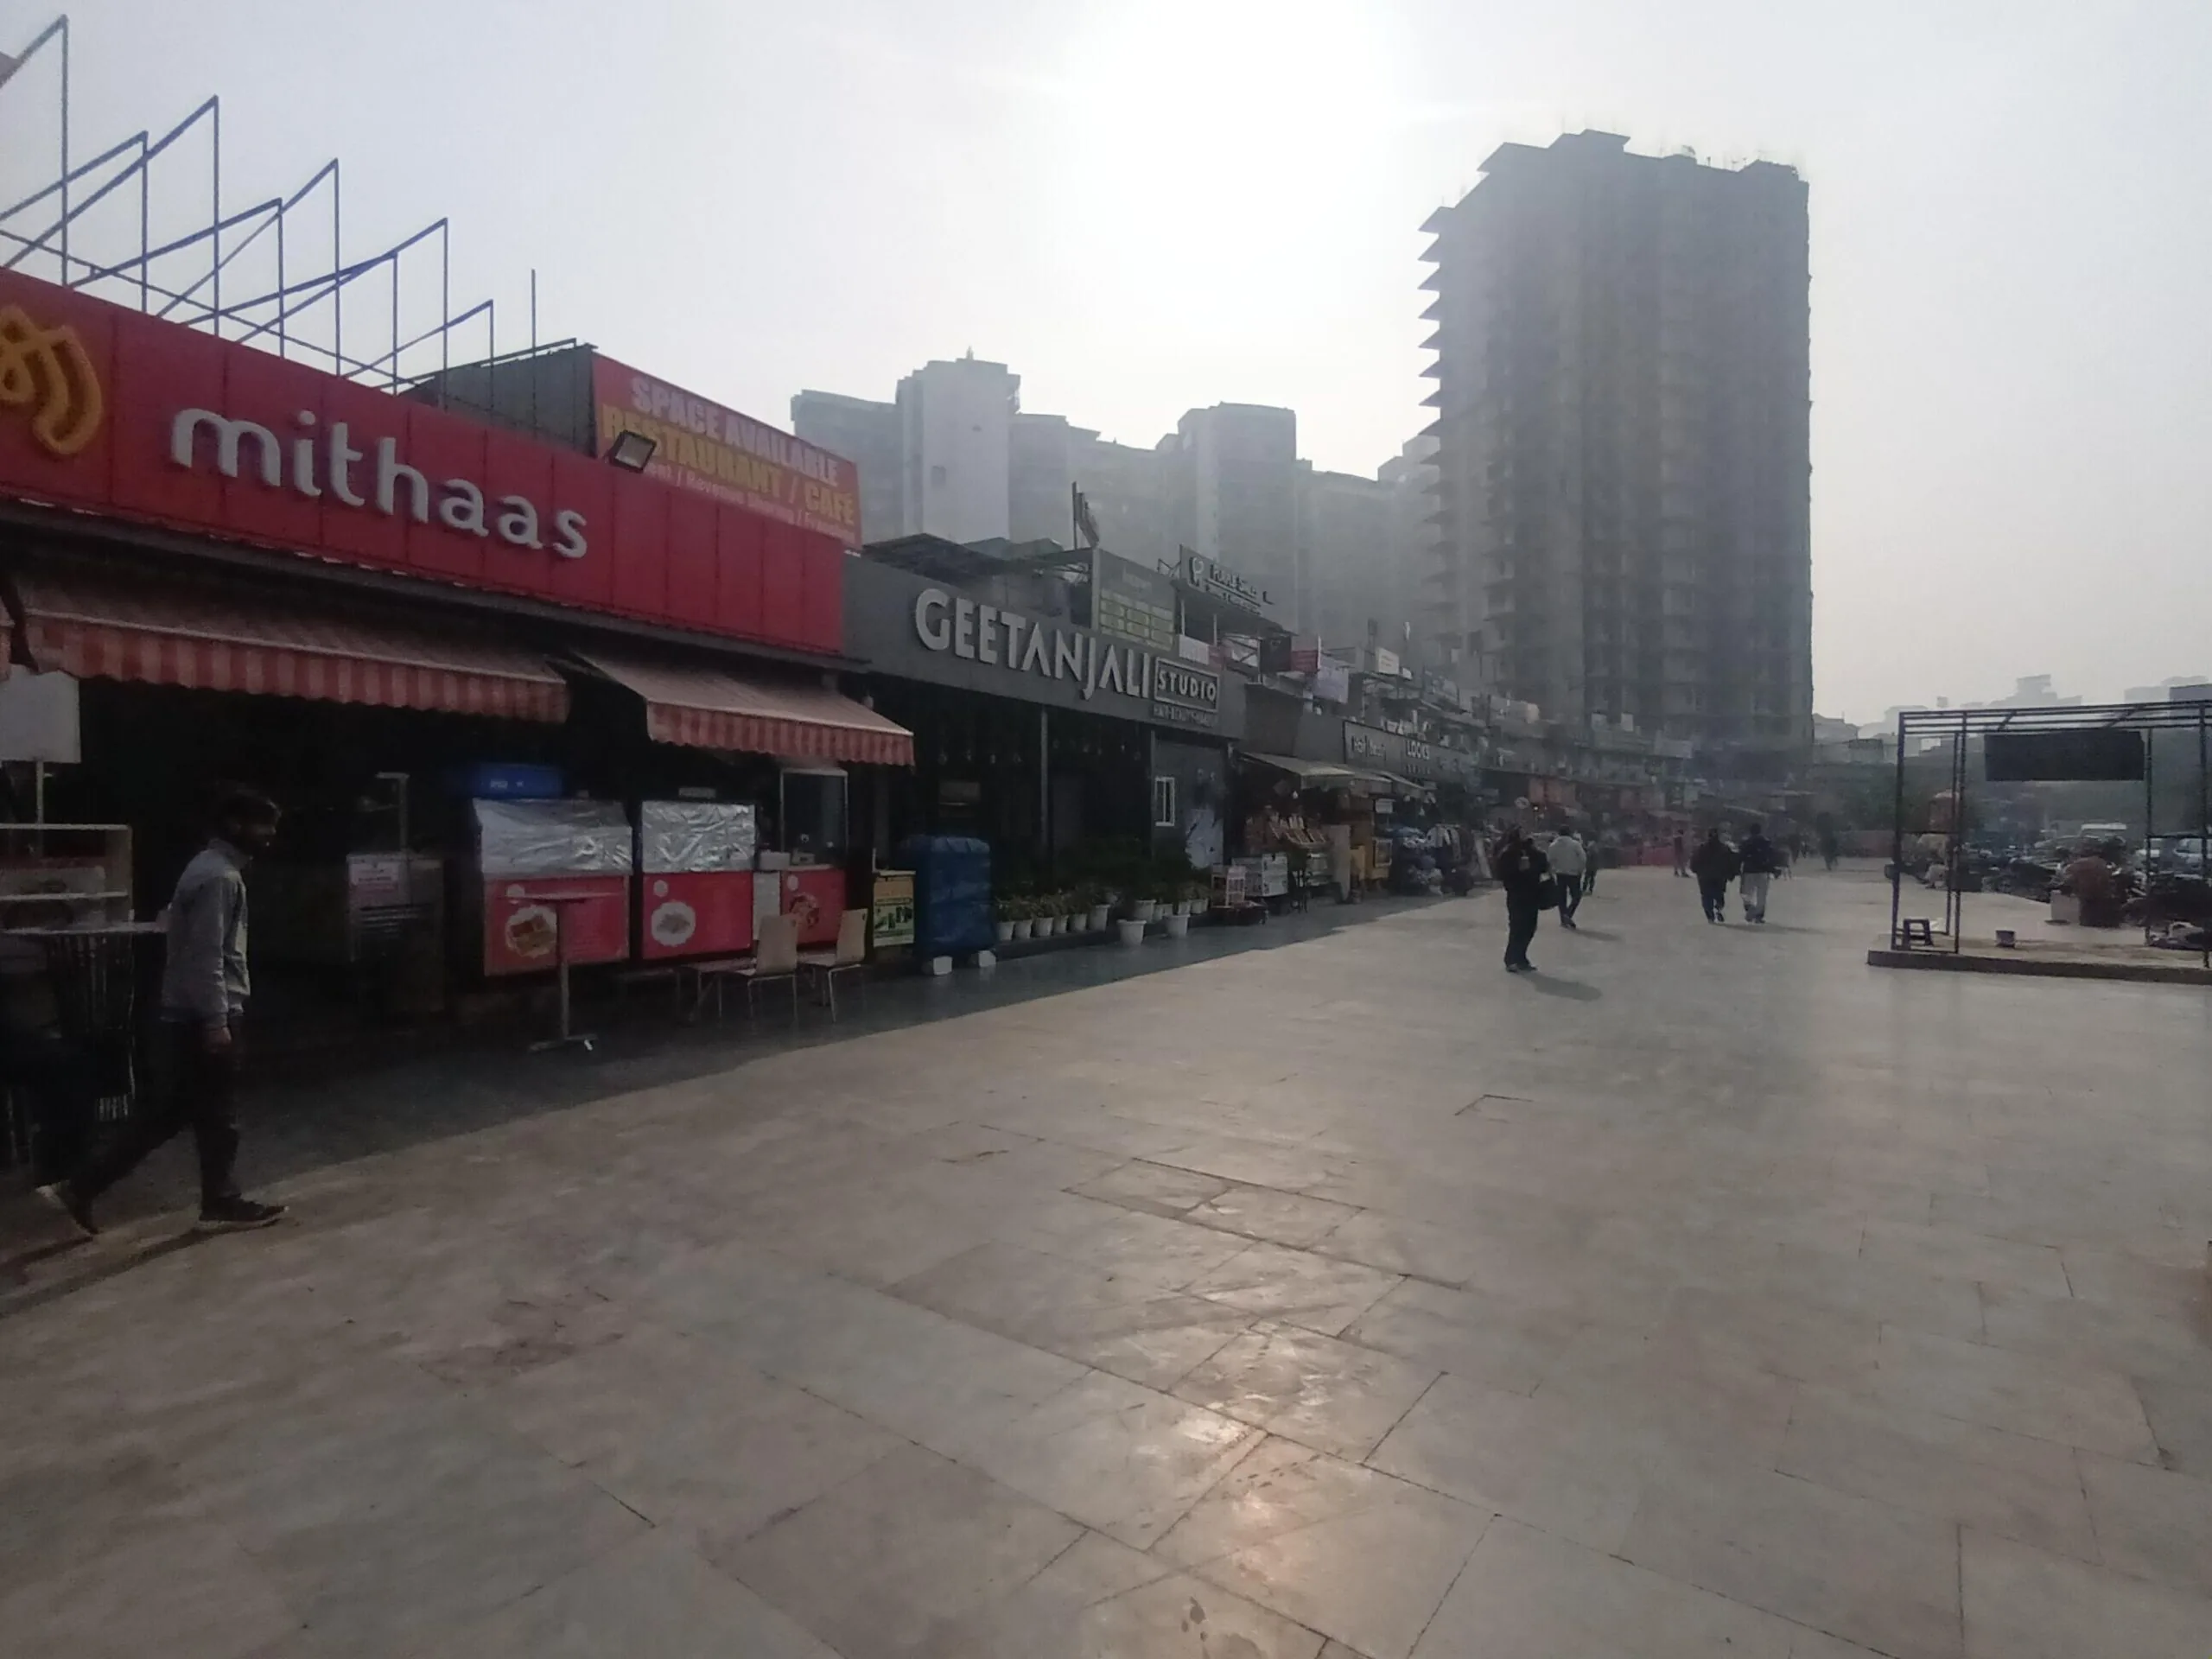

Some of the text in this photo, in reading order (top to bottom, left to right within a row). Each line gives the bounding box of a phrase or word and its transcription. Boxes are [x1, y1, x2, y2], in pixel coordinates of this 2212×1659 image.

[170, 407, 588, 559] mithaas
[632, 376, 839, 487] SPACE AVAILABLE
[915, 588, 1151, 701] GEETANJALI
[1158, 669, 1217, 702] STUDIO
